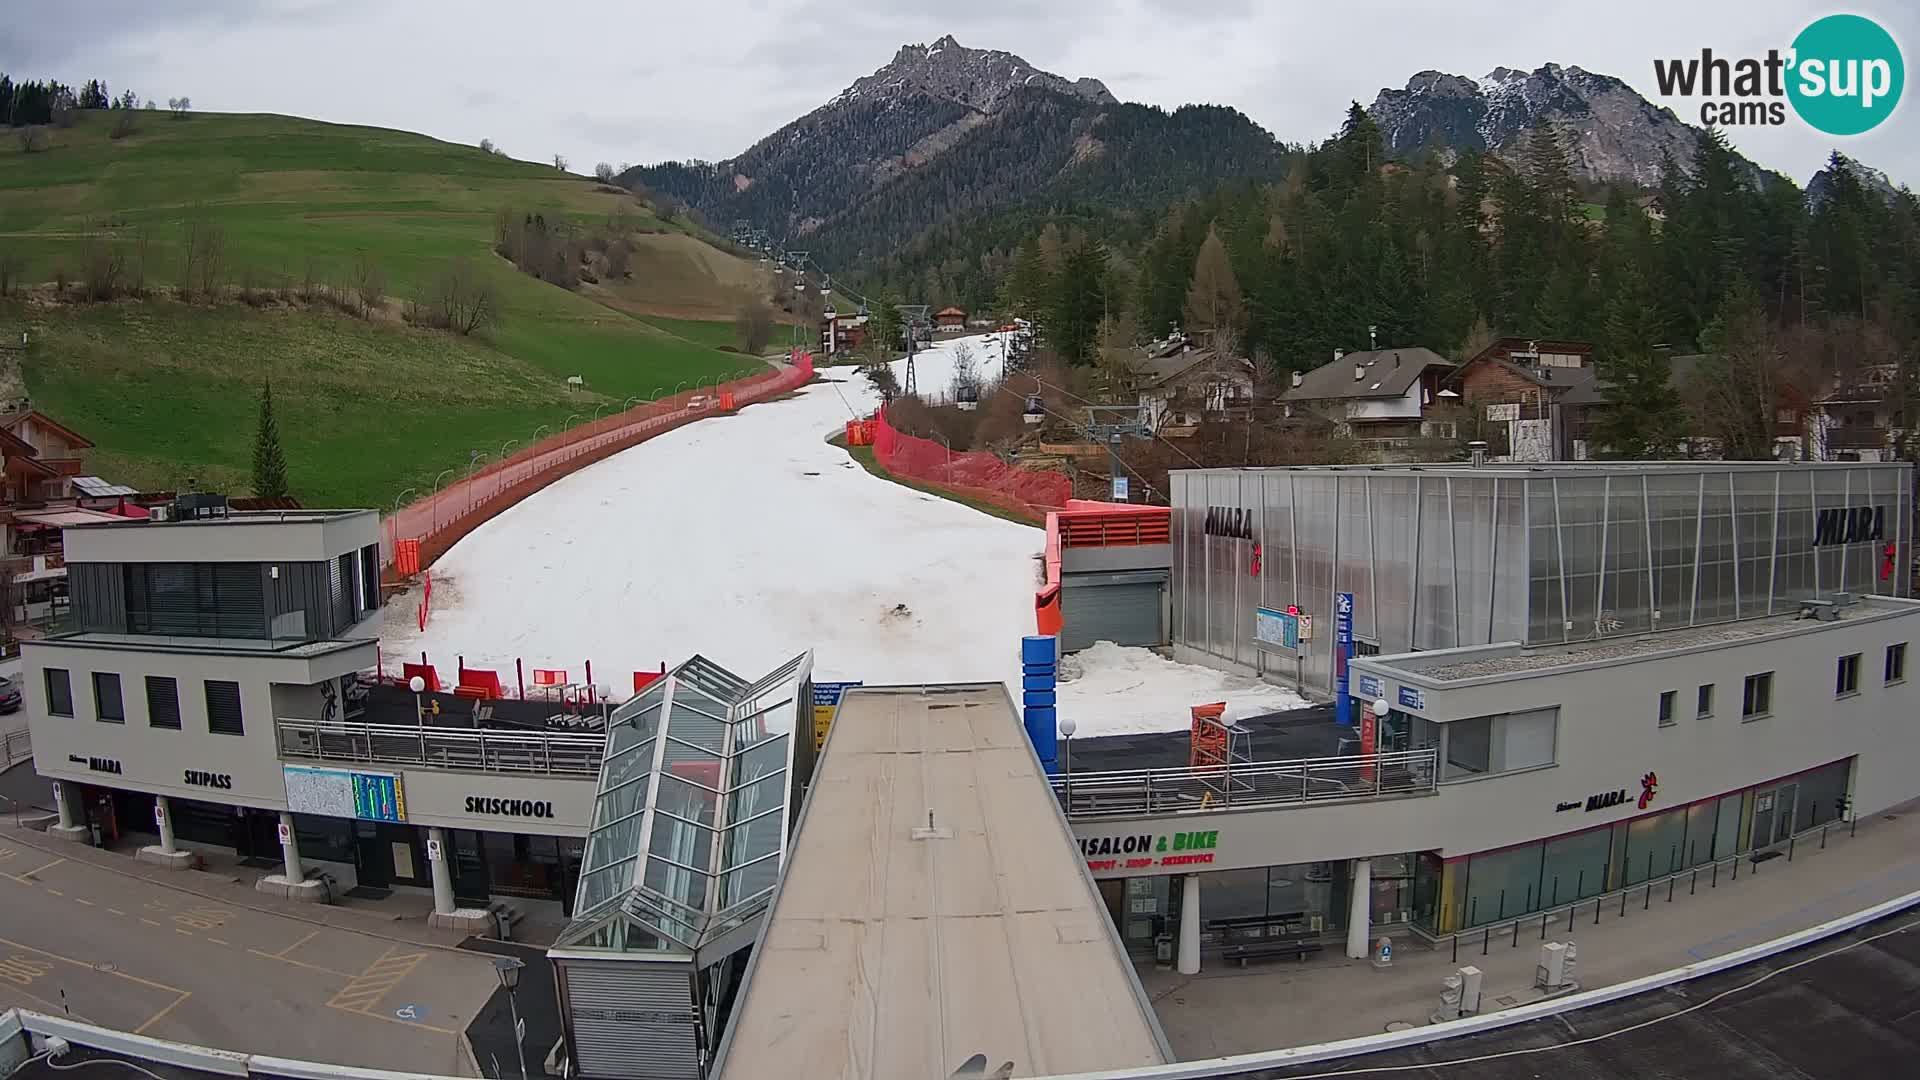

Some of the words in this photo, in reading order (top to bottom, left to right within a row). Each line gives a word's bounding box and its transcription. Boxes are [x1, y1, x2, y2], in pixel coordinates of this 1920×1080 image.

[1205, 506, 1252, 539] MIARA
[1813, 506, 1883, 546] MIARA
[90, 757, 122, 775] MIARA
[184, 769, 232, 789] SKIPASS
[465, 796, 554, 818] SKISCHOOL
[1585, 789, 1626, 812] MIARA
[1076, 835, 1152, 856] ISALON
[1156, 836, 1167, 852] &
[1173, 831, 1218, 850] BIKE
